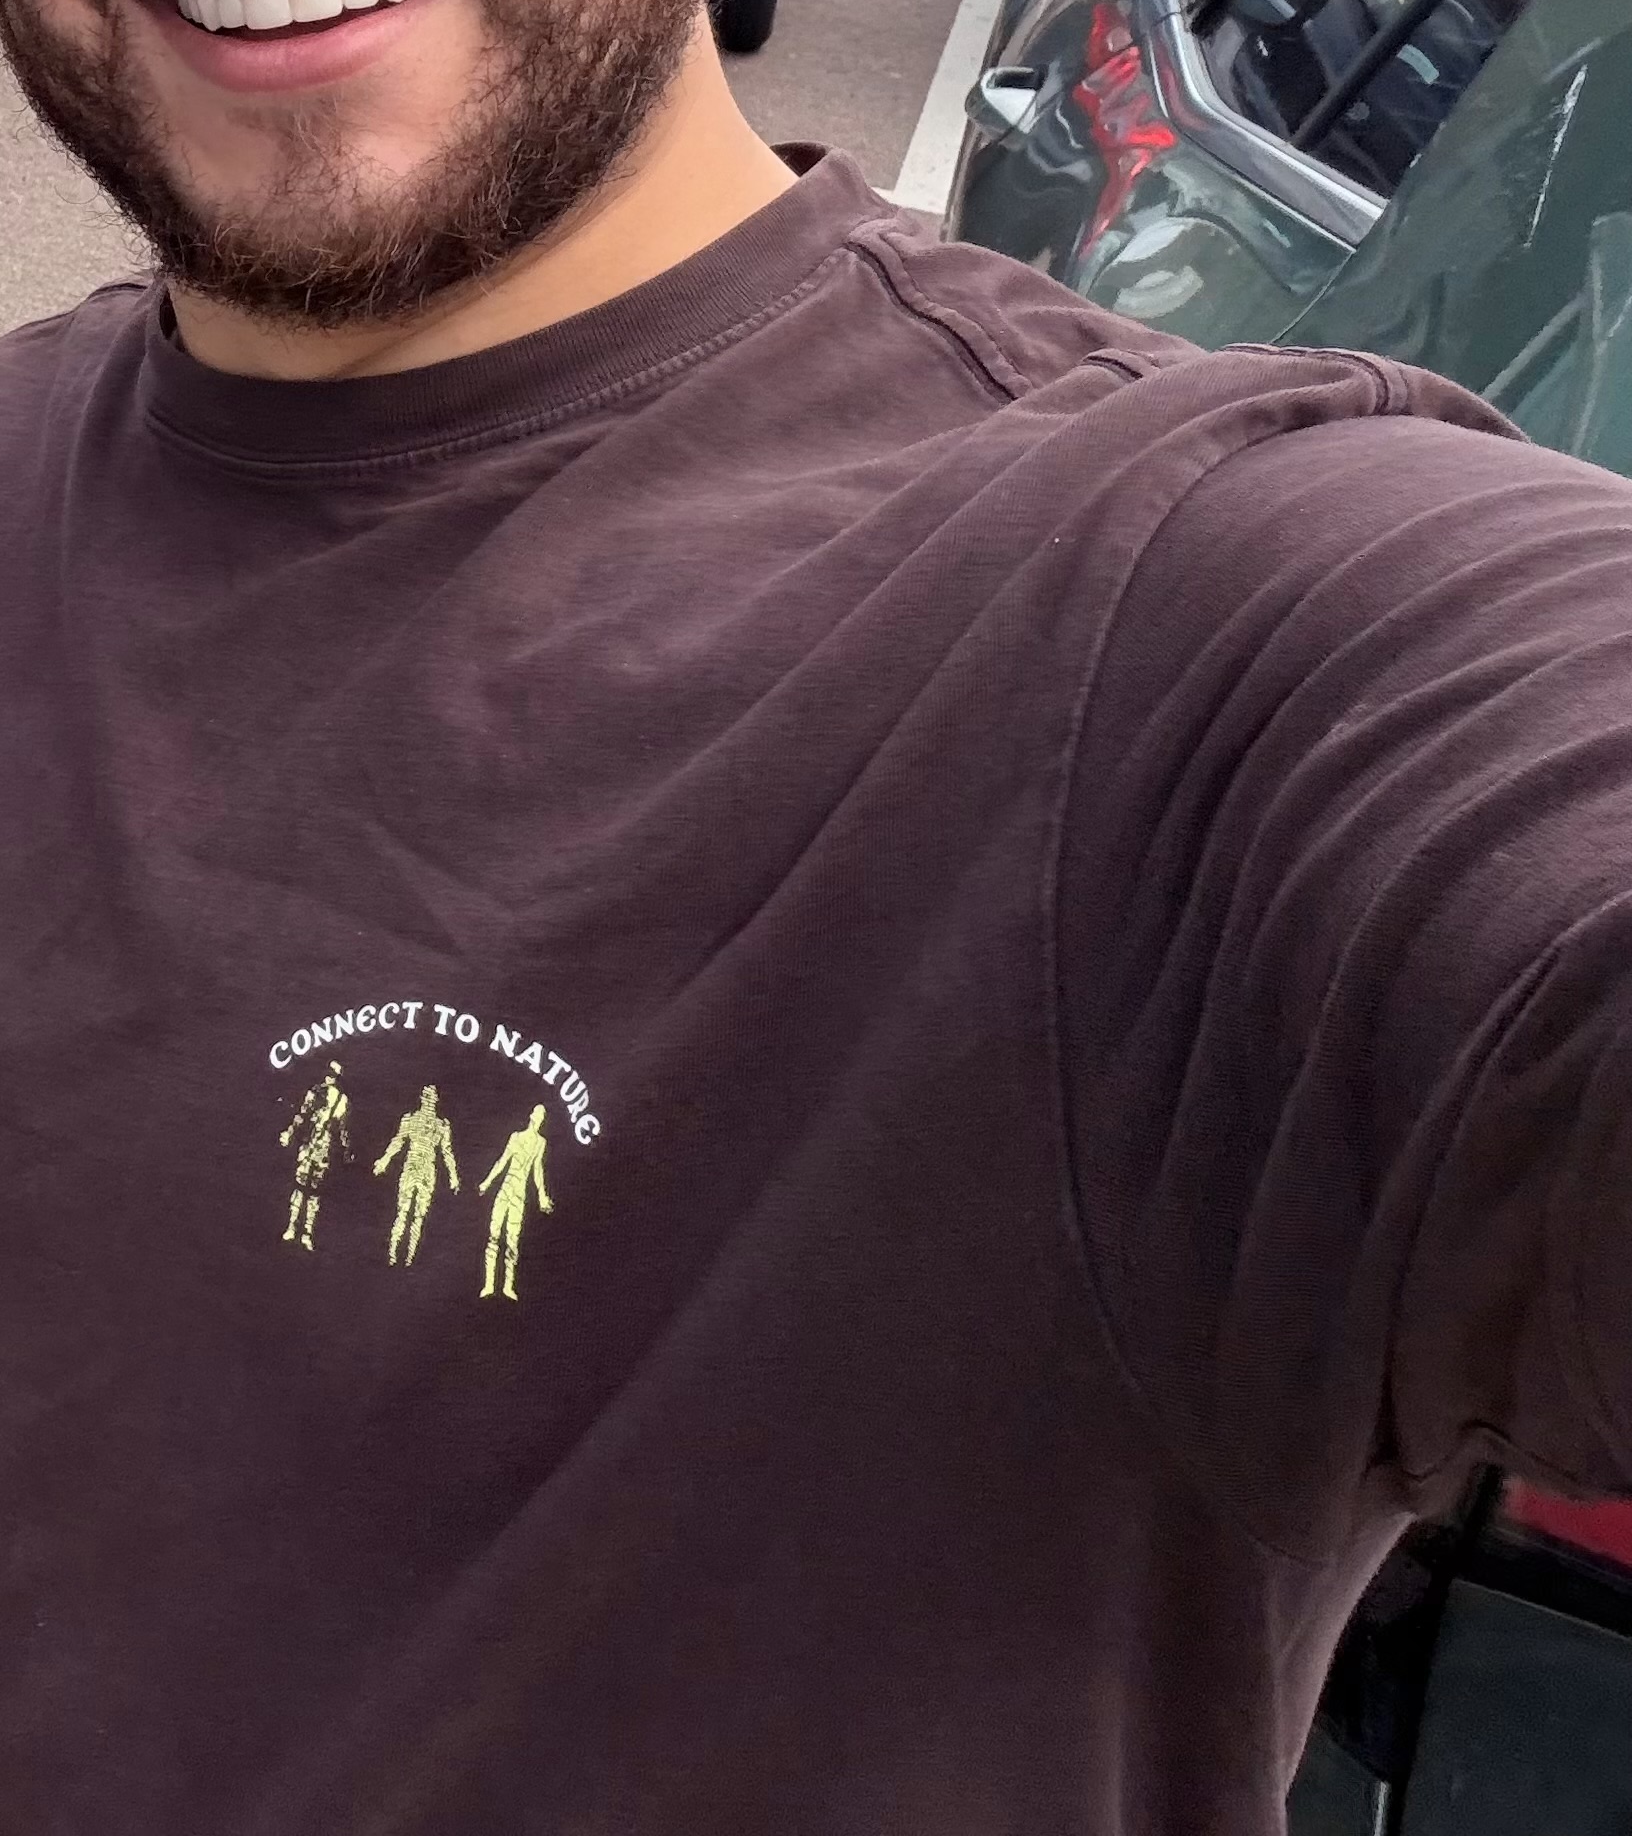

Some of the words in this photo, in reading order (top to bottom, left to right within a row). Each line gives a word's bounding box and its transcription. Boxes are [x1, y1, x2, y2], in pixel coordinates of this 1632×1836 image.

[269, 1001, 424, 1070] CONNECT
[434, 1004, 480, 1043] TO
[489, 1023, 602, 1146] NATURE
